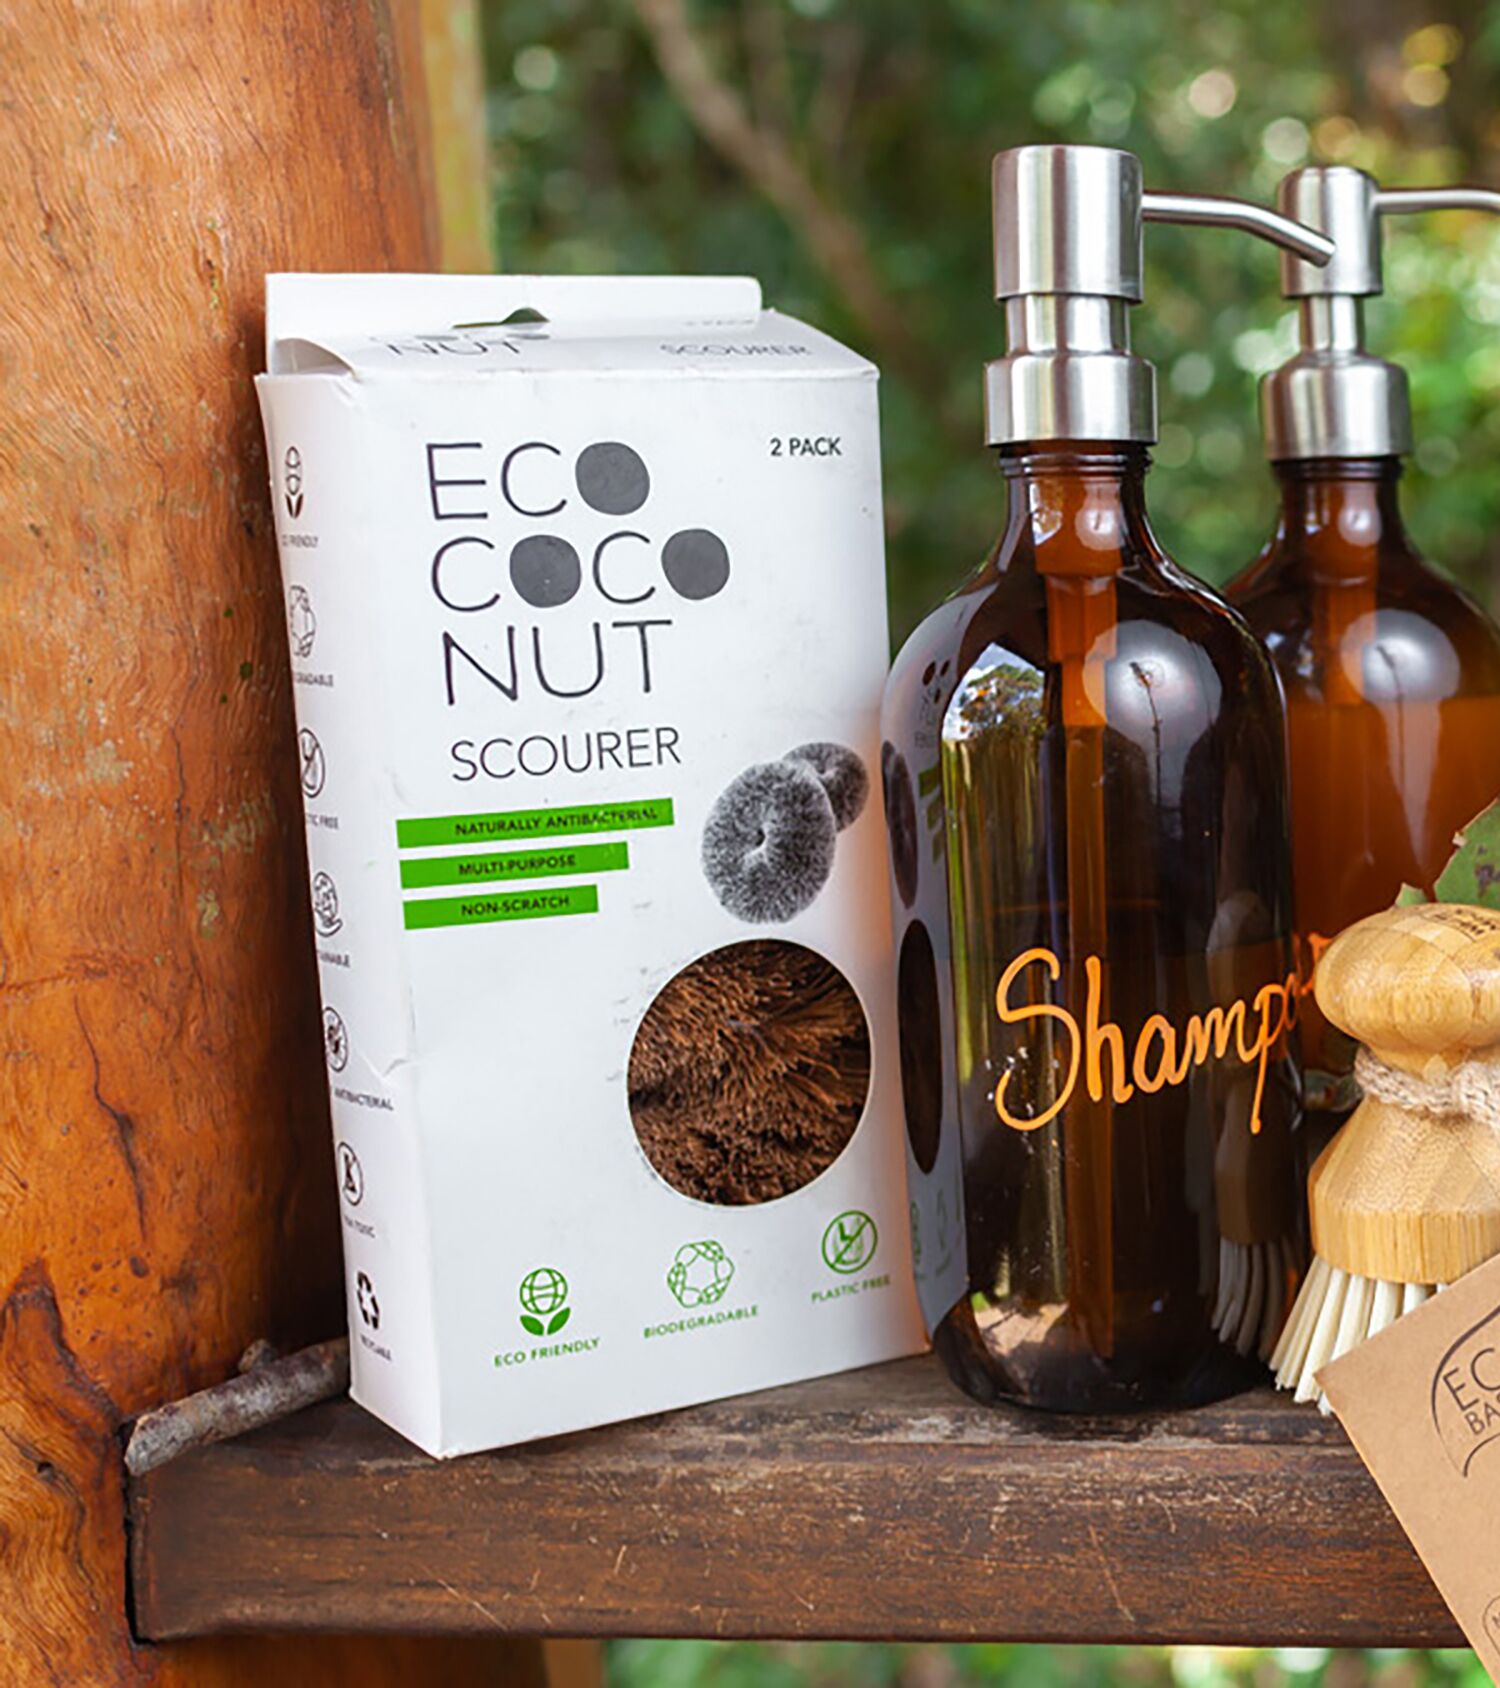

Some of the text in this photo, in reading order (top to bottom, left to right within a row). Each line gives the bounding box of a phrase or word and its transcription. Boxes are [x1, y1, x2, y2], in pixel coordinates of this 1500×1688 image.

[770, 436, 842, 456] 2 PACK
[426, 441, 651, 520] ECO
[431, 528, 731, 612] COCO
[442, 619, 673, 706] NUT
[451, 727, 682, 782] SCOURER
[455, 807, 658, 836] NATURALLY ANTIBACTERIAL
[458, 854, 576, 876] MULTI-PURPOSE
[460, 895, 570, 917] NON-SCRATCH
[811, 1281, 859, 1304] PLASTIC
[862, 1274, 891, 1290] FREE
[644, 1304, 758, 1338] BIODEGRADABLE
[494, 1337, 600, 1368] ECO FRIENDLY
